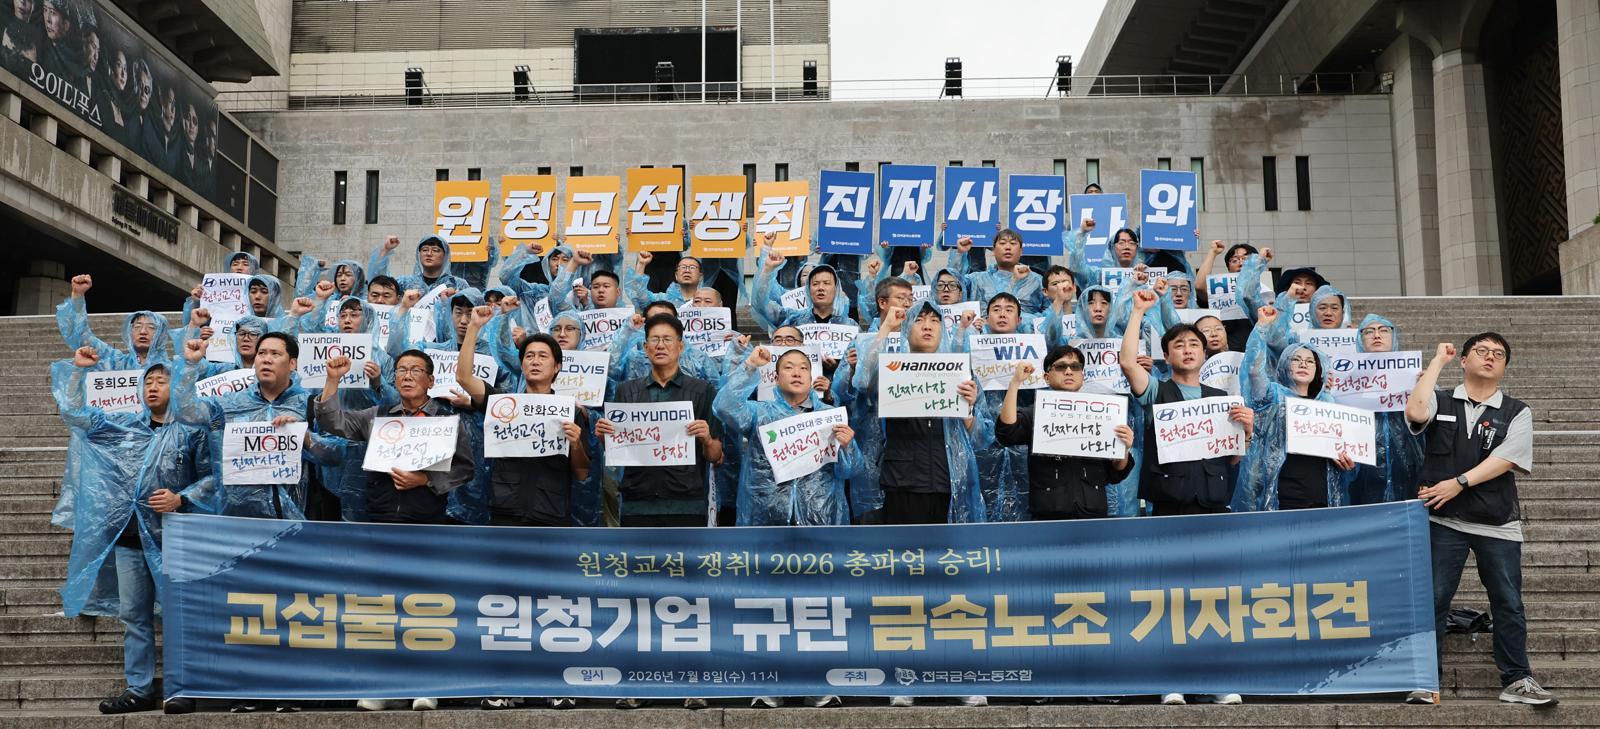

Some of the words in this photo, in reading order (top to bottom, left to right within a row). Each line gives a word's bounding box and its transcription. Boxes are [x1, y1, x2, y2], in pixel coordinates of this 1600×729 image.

[28, 62, 103, 127] 오이디푸스
[627, 184, 682, 234] 섭
[822, 184, 871, 229] 진
[881, 179, 934, 223] 짜
[947, 181, 998, 224] 사
[1013, 188, 1063, 231] 장
[1146, 183, 1194, 227] 와
[435, 195, 488, 244] 원
[502, 190, 555, 241] 청
[565, 191, 618, 236] 교
[690, 191, 746, 241] 쟁
[757, 195, 808, 241] 취
[219, 277, 248, 287] HYUN
[202, 289, 242, 303] 원청교섭
[234, 303, 247, 315] 당
[582, 312, 607, 321] UNDAI
[302, 337, 342, 345] HYUNDAI
[976, 337, 1017, 345] HYUNDAI
[1309, 336, 1357, 347] 한국무브
[313, 345, 366, 361] MOBIS
[561, 364, 605, 375] LOVIS
[975, 361, 1016, 378] 진짜사
[1357, 357, 1421, 370] HYUNDAI
[1201, 364, 1239, 382] GLOVI
[93, 376, 138, 390] 동희오토
[887, 380, 947, 399] 진짜사장
[1334, 374, 1388, 392] 원청교섭
[523, 404, 571, 418] 한화오션
[924, 394, 960, 412] 나와!
[631, 409, 692, 422] HYUNDAI
[1050, 412, 1113, 422] SYSTEMS
[1315, 407, 1372, 425] HYUNDAI
[231, 426, 276, 434] HYUNDAI
[408, 425, 454, 438] 한화오션
[493, 422, 546, 441] 원청교섭
[1042, 422, 1102, 438] 진짜사장
[1159, 419, 1215, 441] 원청교섭
[1293, 419, 1344, 437] 원청교섭
[244, 435, 298, 452] MOBIS
[376, 441, 429, 458] 원청교섭
[532, 435, 568, 453] 당장!
[652, 442, 688, 462] 당장!
[772, 432, 821, 462] 원청교섭
[1080, 439, 1116, 456] 나와!
[1207, 434, 1240, 455] 당장!
[1334, 442, 1369, 458] 당장!
[232, 452, 287, 470] 진짜사장
[411, 451, 448, 468] 당장!
[272, 462, 299, 480] 나와!
[576, 551, 686, 578] 원청교섭
[697, 551, 760, 577] 쟁취!
[770, 552, 834, 575] 2026
[843, 548, 926, 577] 총파업
[937, 546, 1001, 576] 승리!
[223, 591, 459, 652] 교섭불응
[476, 594, 712, 653] 원청기업
[732, 595, 852, 653] 규탄
[869, 590, 1111, 652] 금속노조
[1129, 579, 1372, 645] 기자회견
[580, 669, 605, 682] 일시
[628, 670, 674, 683] 2026년
[678, 670, 699, 683] 7월
[702, 670, 746, 684] 8일(수)
[750, 670, 779, 683] 11시
[844, 670, 868, 682] 주최
[922, 669, 1033, 683] 전국금속노동조합
